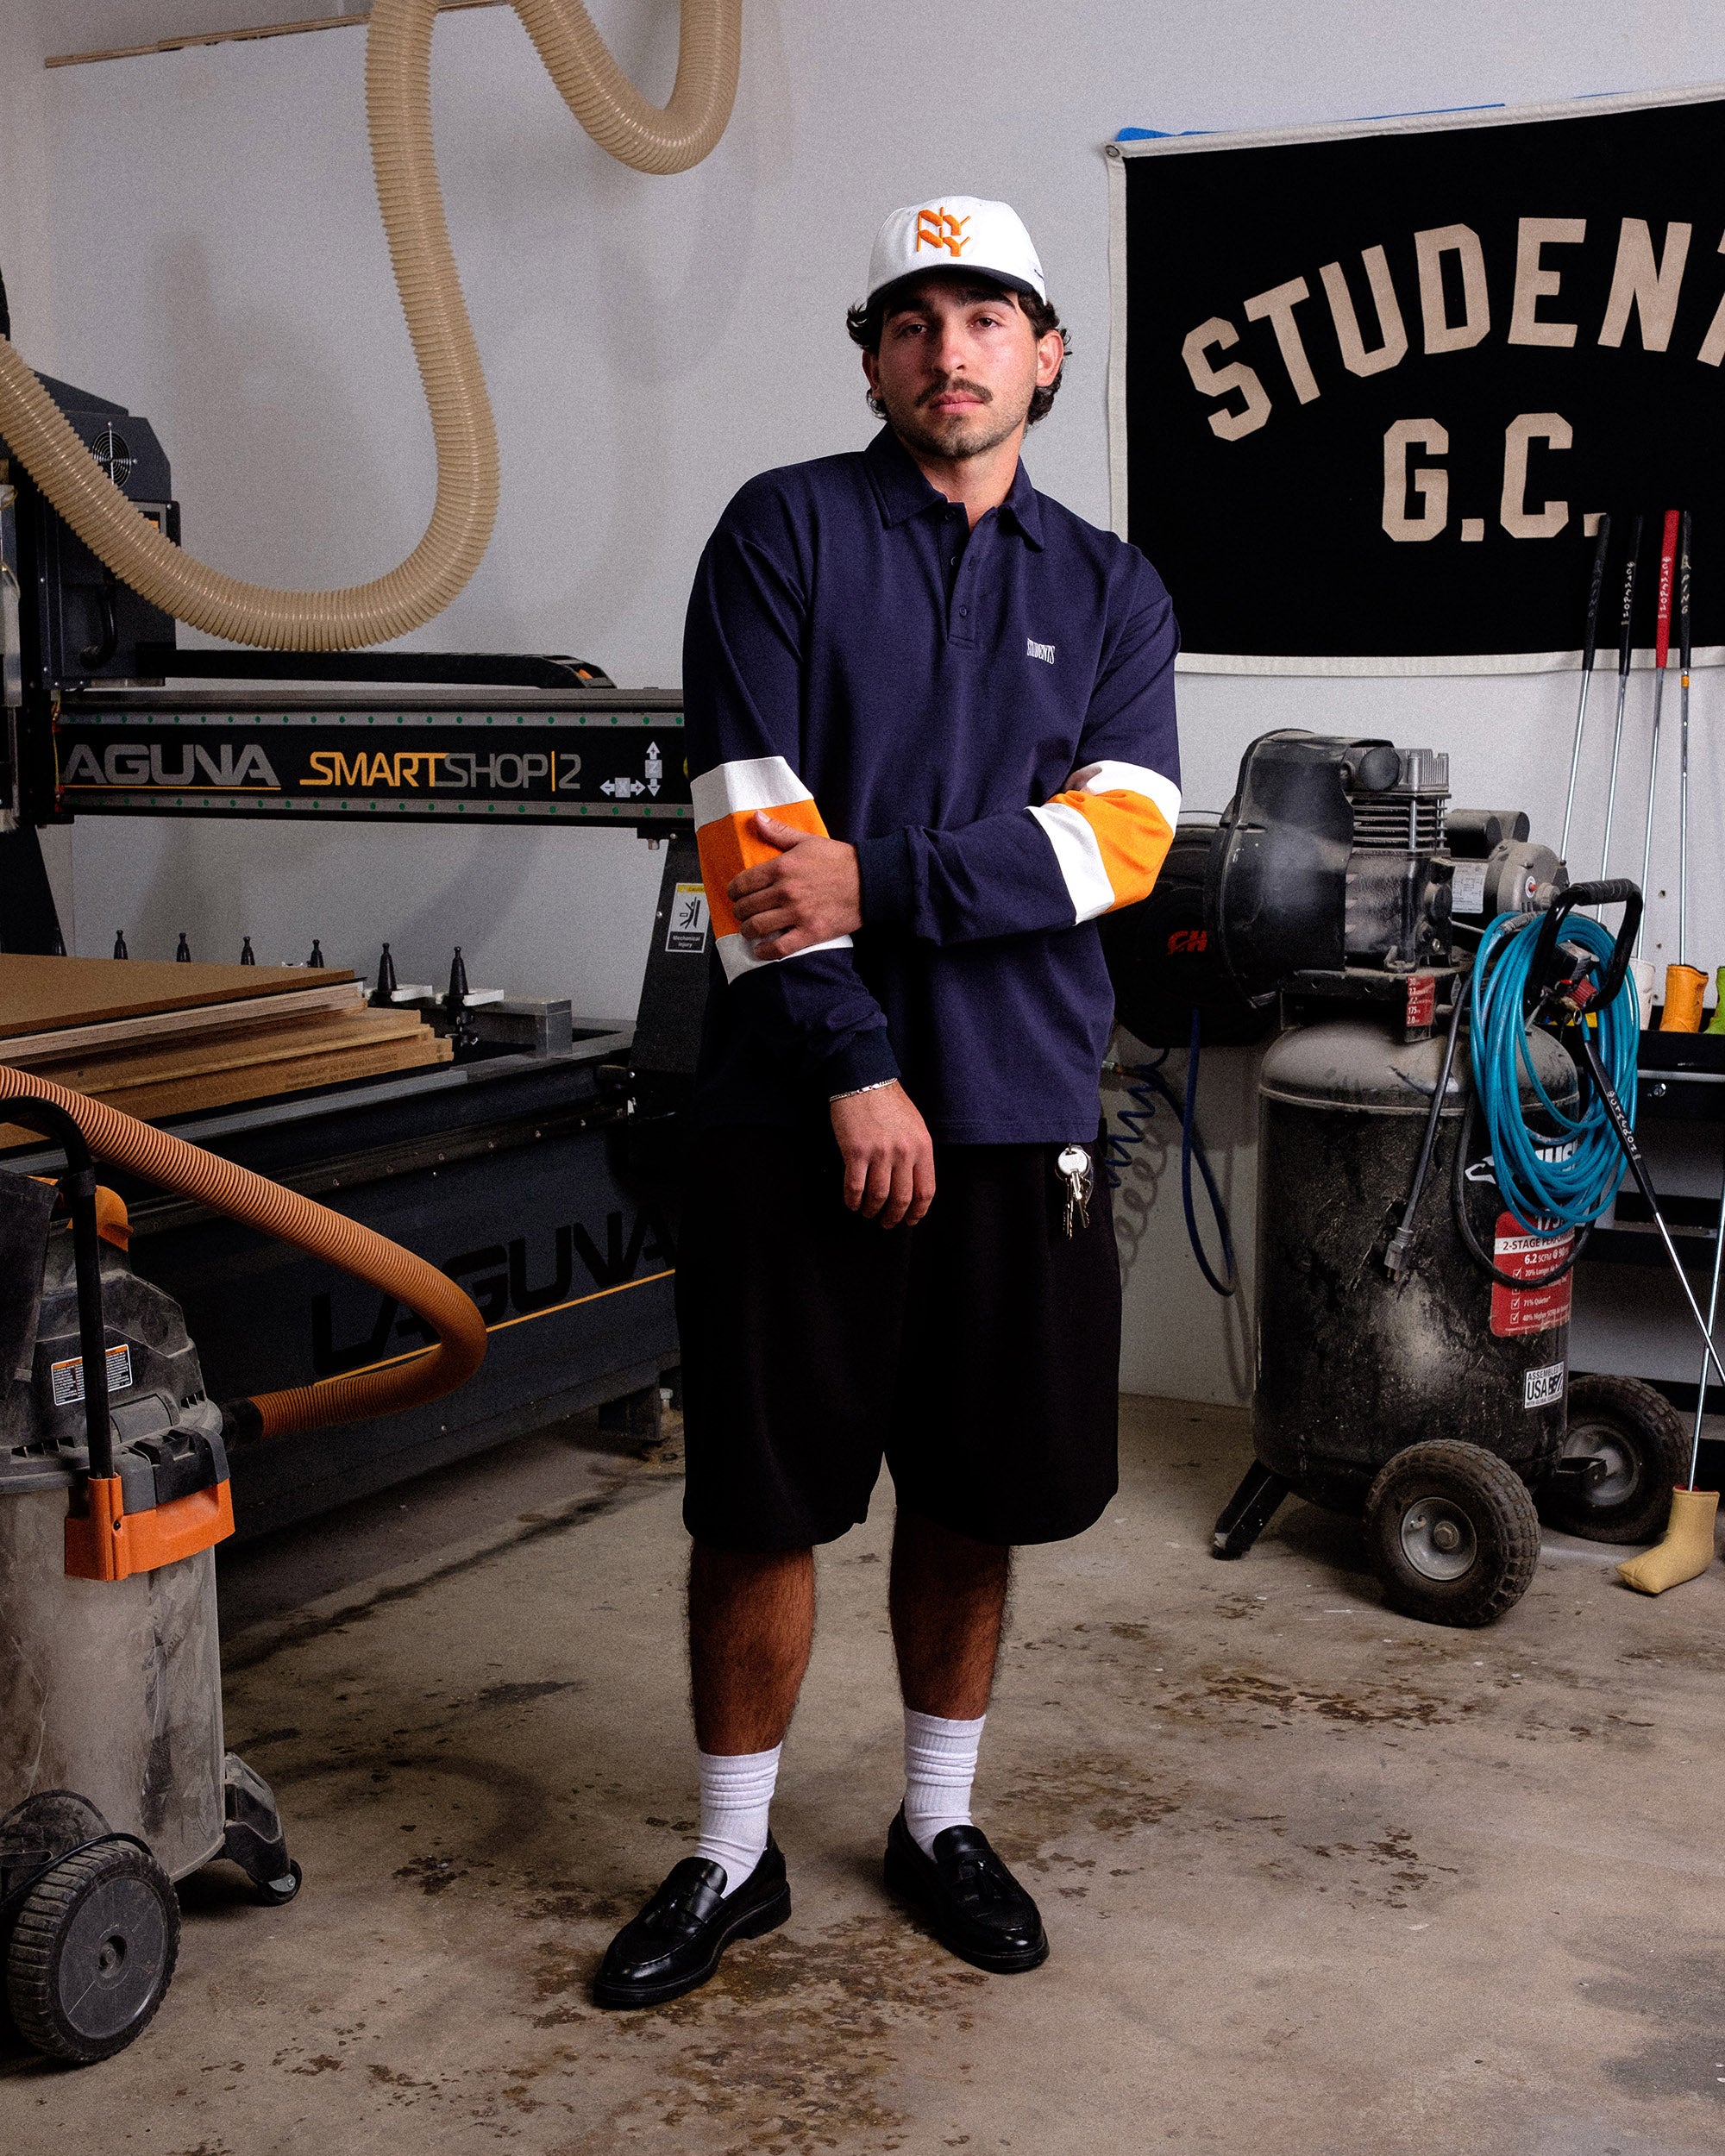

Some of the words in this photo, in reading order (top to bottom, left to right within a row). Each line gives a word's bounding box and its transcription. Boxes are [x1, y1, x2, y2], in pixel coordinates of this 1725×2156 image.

[1382, 412, 1606, 542] G.C.
[58, 743, 281, 787] AGUNA
[1502, 1238, 1540, 1250] 2-STAGE
[1524, 1253, 1538, 1264] 6.2
[1527, 1378, 1547, 1401] USA
